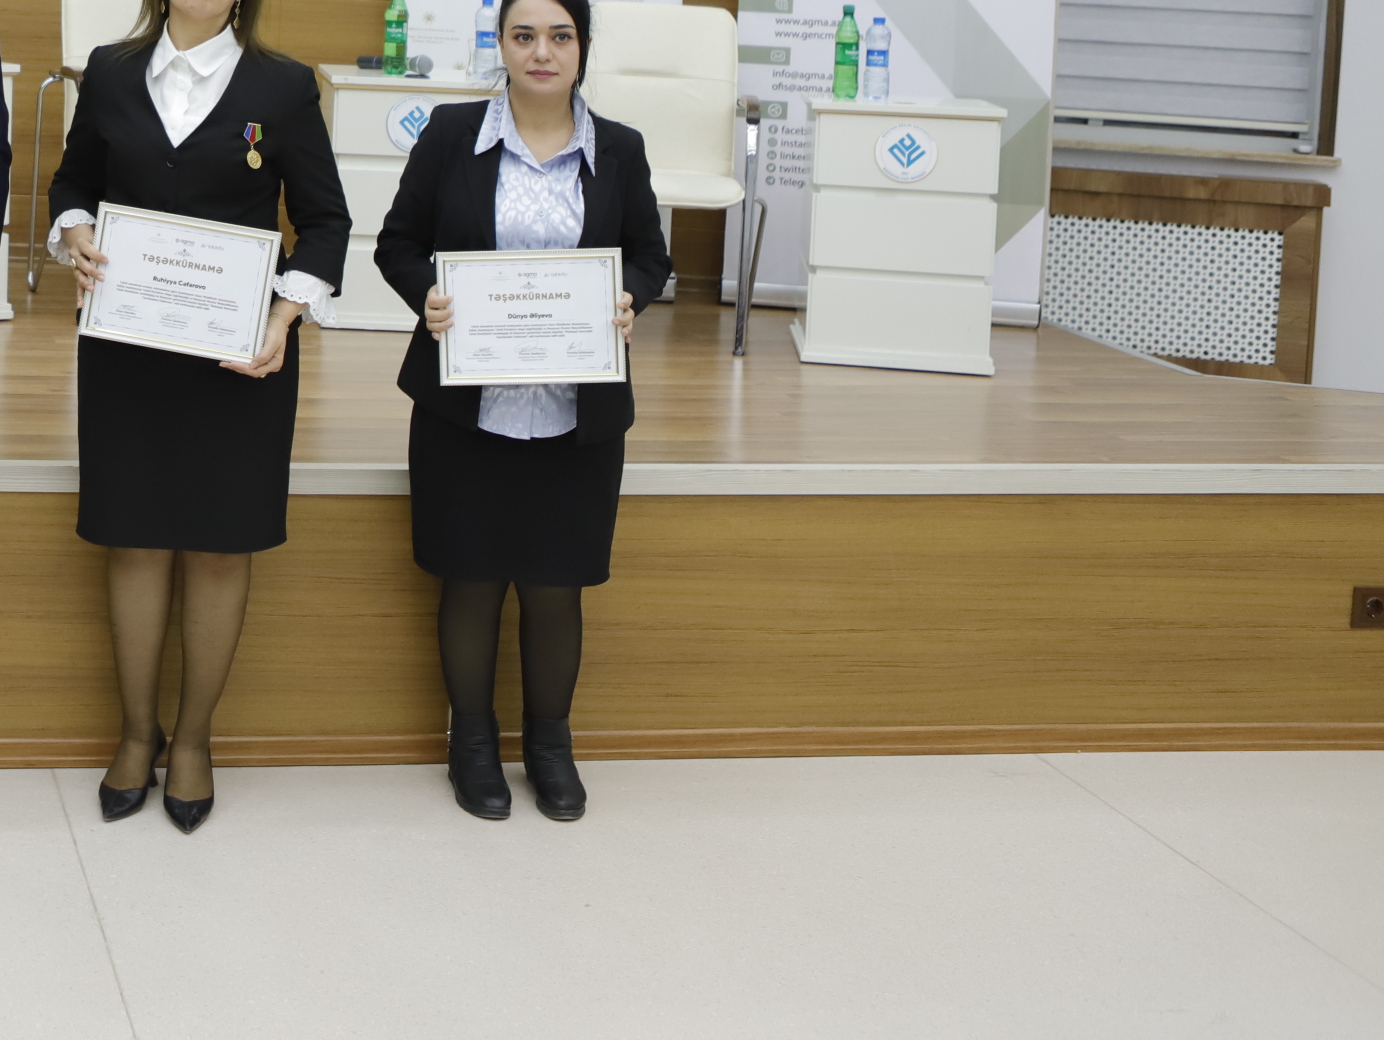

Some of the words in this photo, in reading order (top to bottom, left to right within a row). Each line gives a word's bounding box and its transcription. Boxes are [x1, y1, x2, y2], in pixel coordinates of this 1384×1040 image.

[775, 17, 841, 29] www.agma.az
[772, 69, 834, 82] info@agma.a
[142, 253, 223, 275] TƏŞƏKKÜRNAMƏ
[488, 291, 571, 304] TƏŞƏKKÜRNAMƏ
